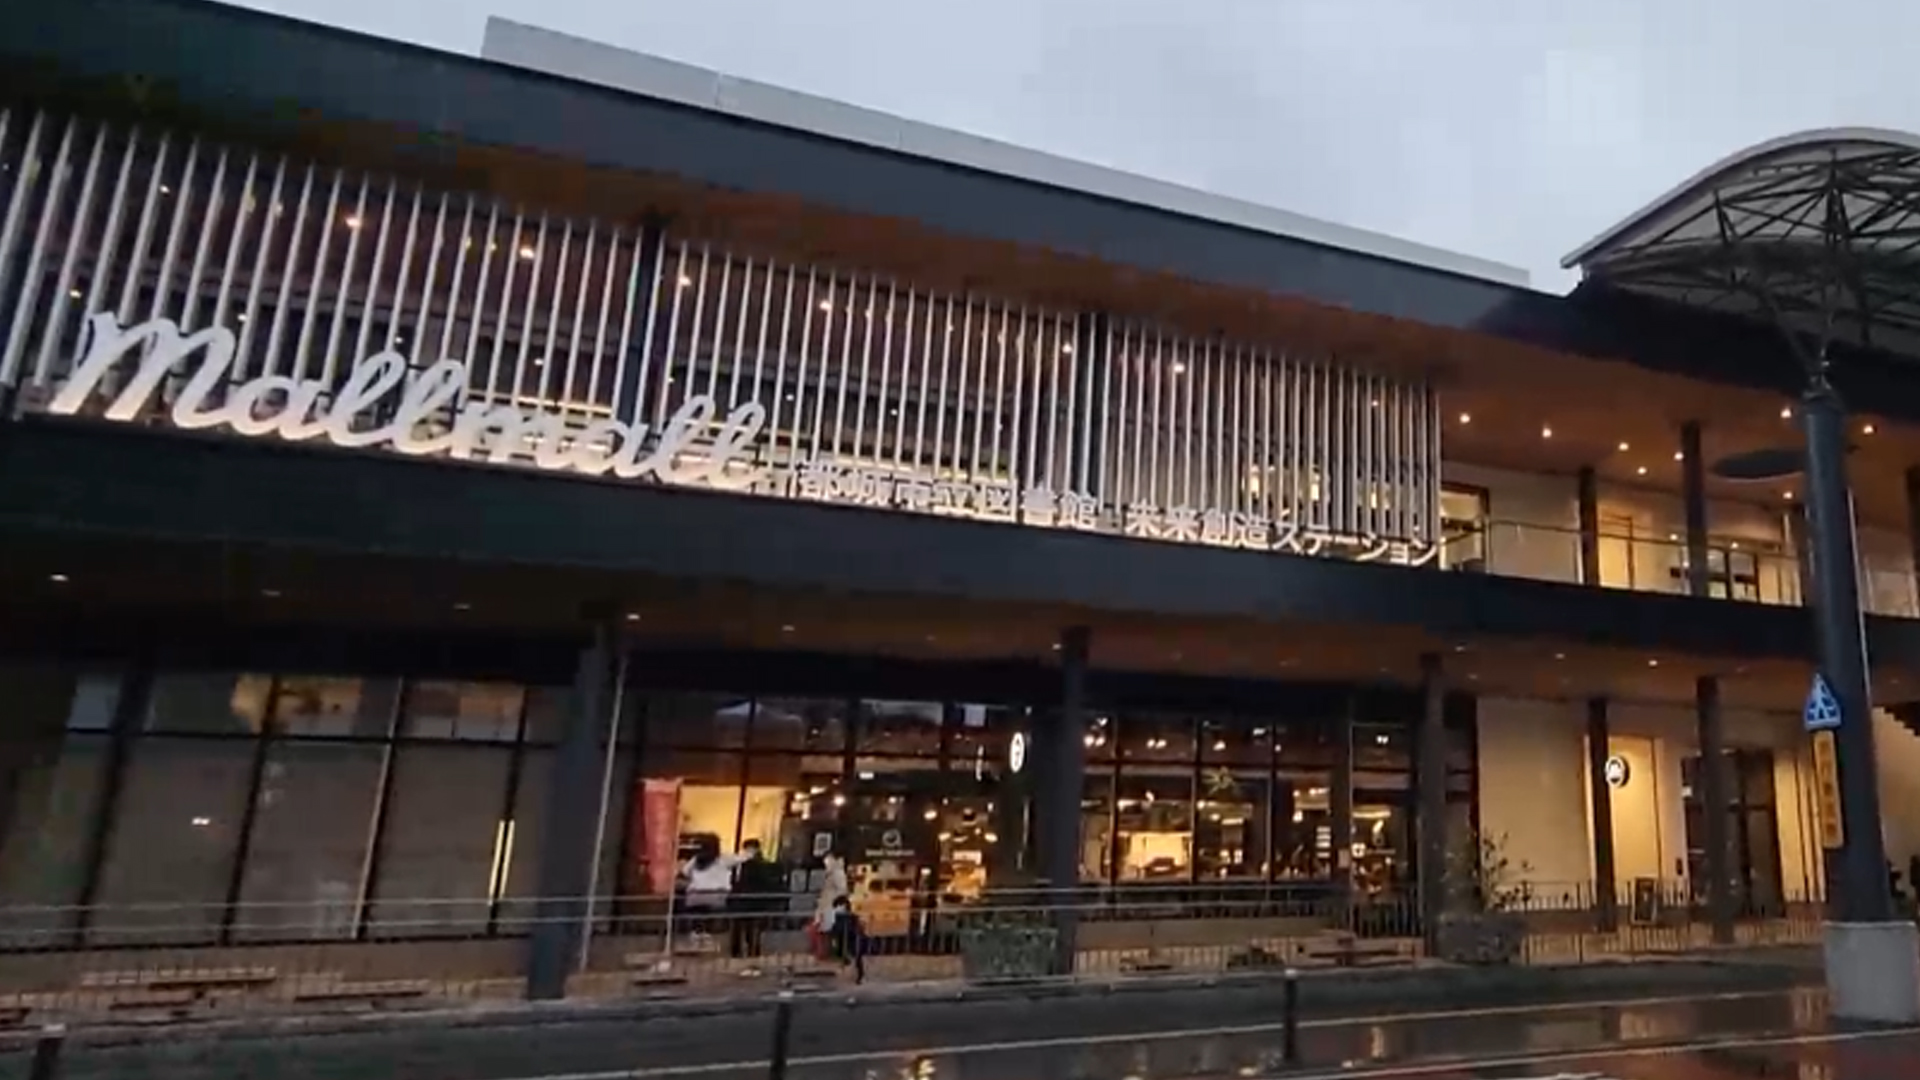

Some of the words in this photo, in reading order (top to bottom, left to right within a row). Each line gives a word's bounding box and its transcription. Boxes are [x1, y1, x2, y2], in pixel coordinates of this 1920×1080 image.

[1124, 498, 1438, 568] 未来創造ステーション
